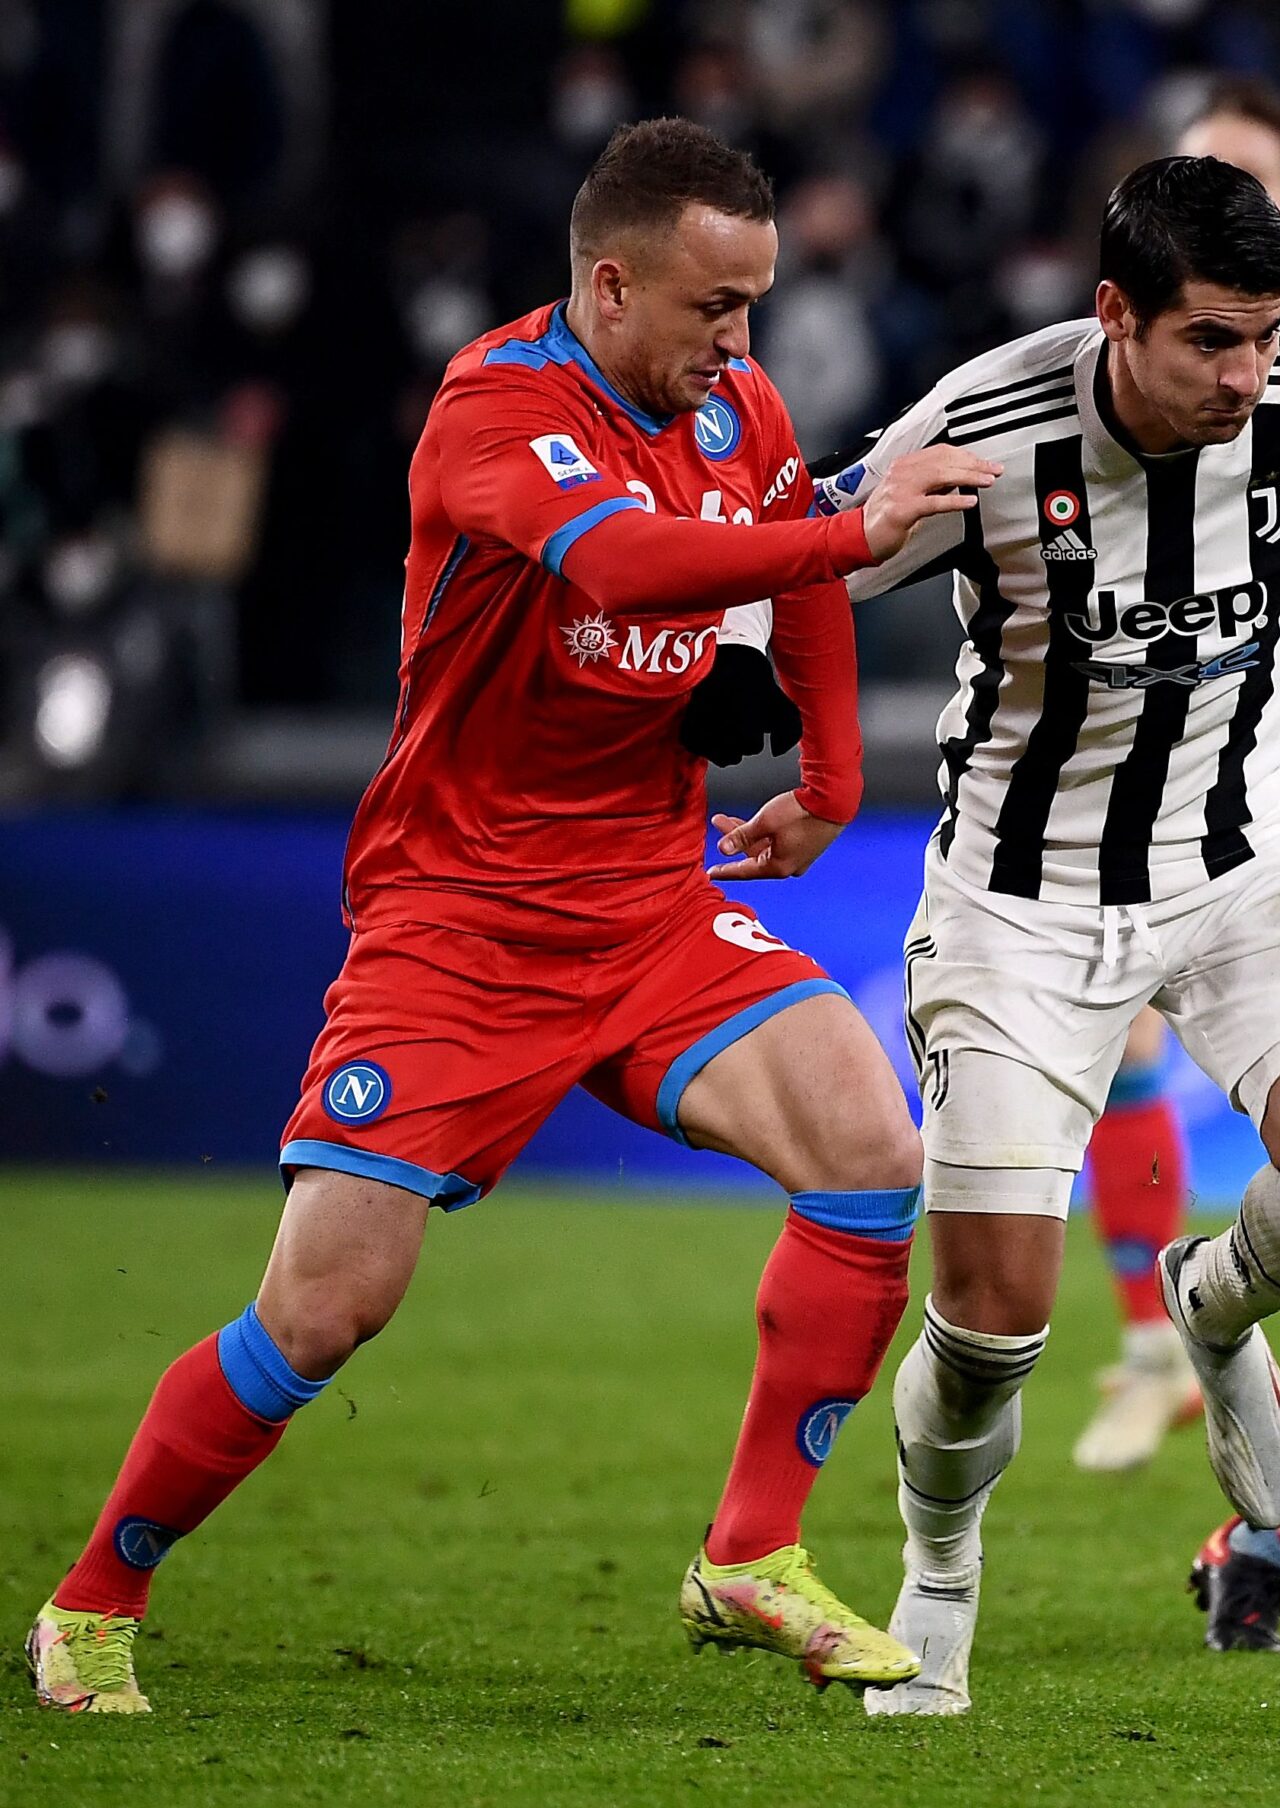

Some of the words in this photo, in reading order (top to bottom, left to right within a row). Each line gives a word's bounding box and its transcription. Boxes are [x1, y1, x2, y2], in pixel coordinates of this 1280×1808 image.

[695, 409, 724, 442] N
[1041, 548, 1097, 562] adidas
[1065, 581, 1268, 643] Jeep
[336, 1076, 377, 1111] N
